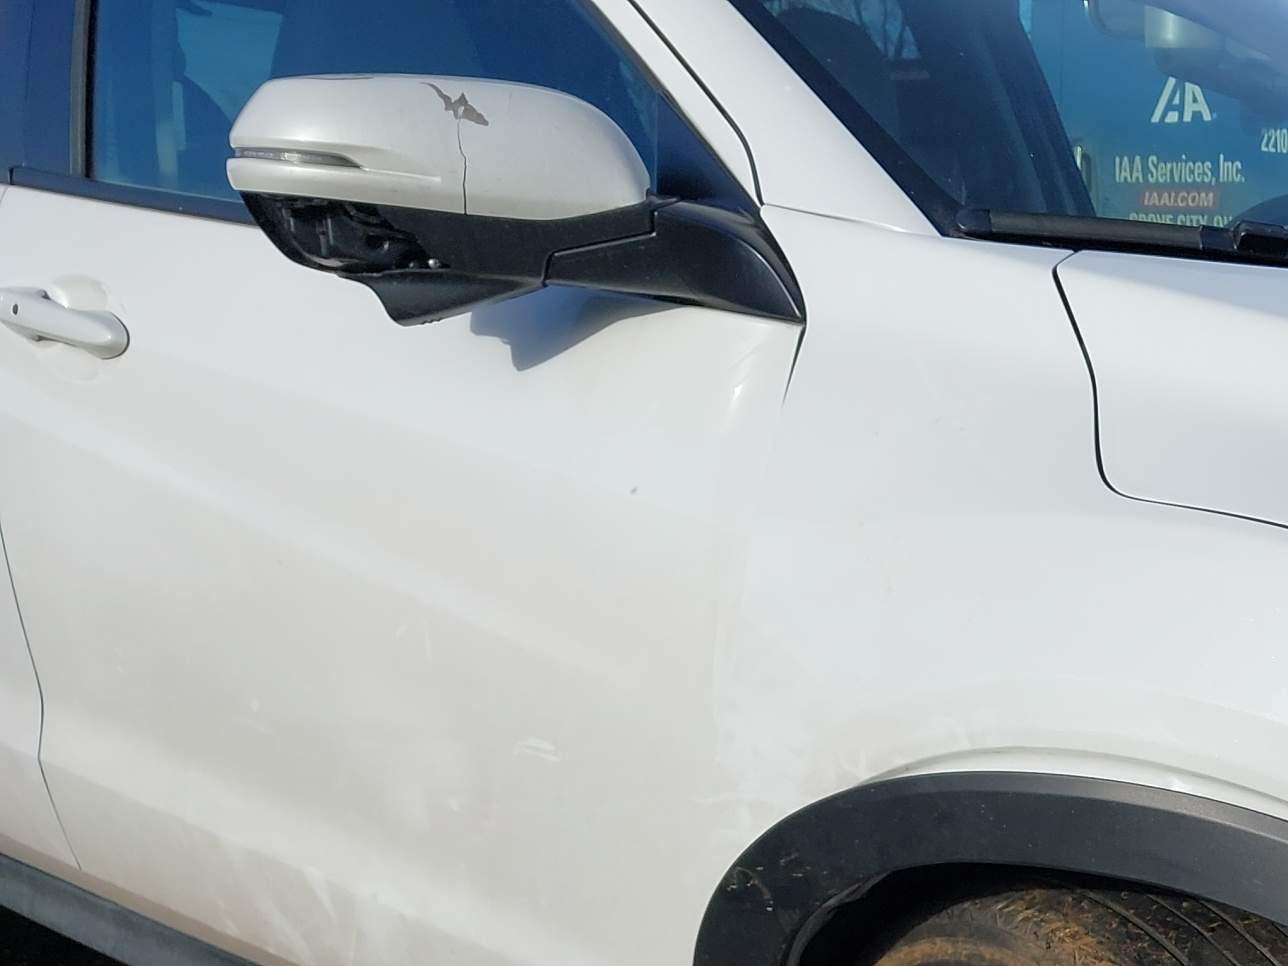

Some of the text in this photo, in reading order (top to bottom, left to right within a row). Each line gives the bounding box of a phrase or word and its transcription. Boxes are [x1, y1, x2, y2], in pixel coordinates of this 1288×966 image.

[1115, 154, 1245, 184] IAA Services, Inc.
[1144, 191, 1213, 207] IAAI.COM
